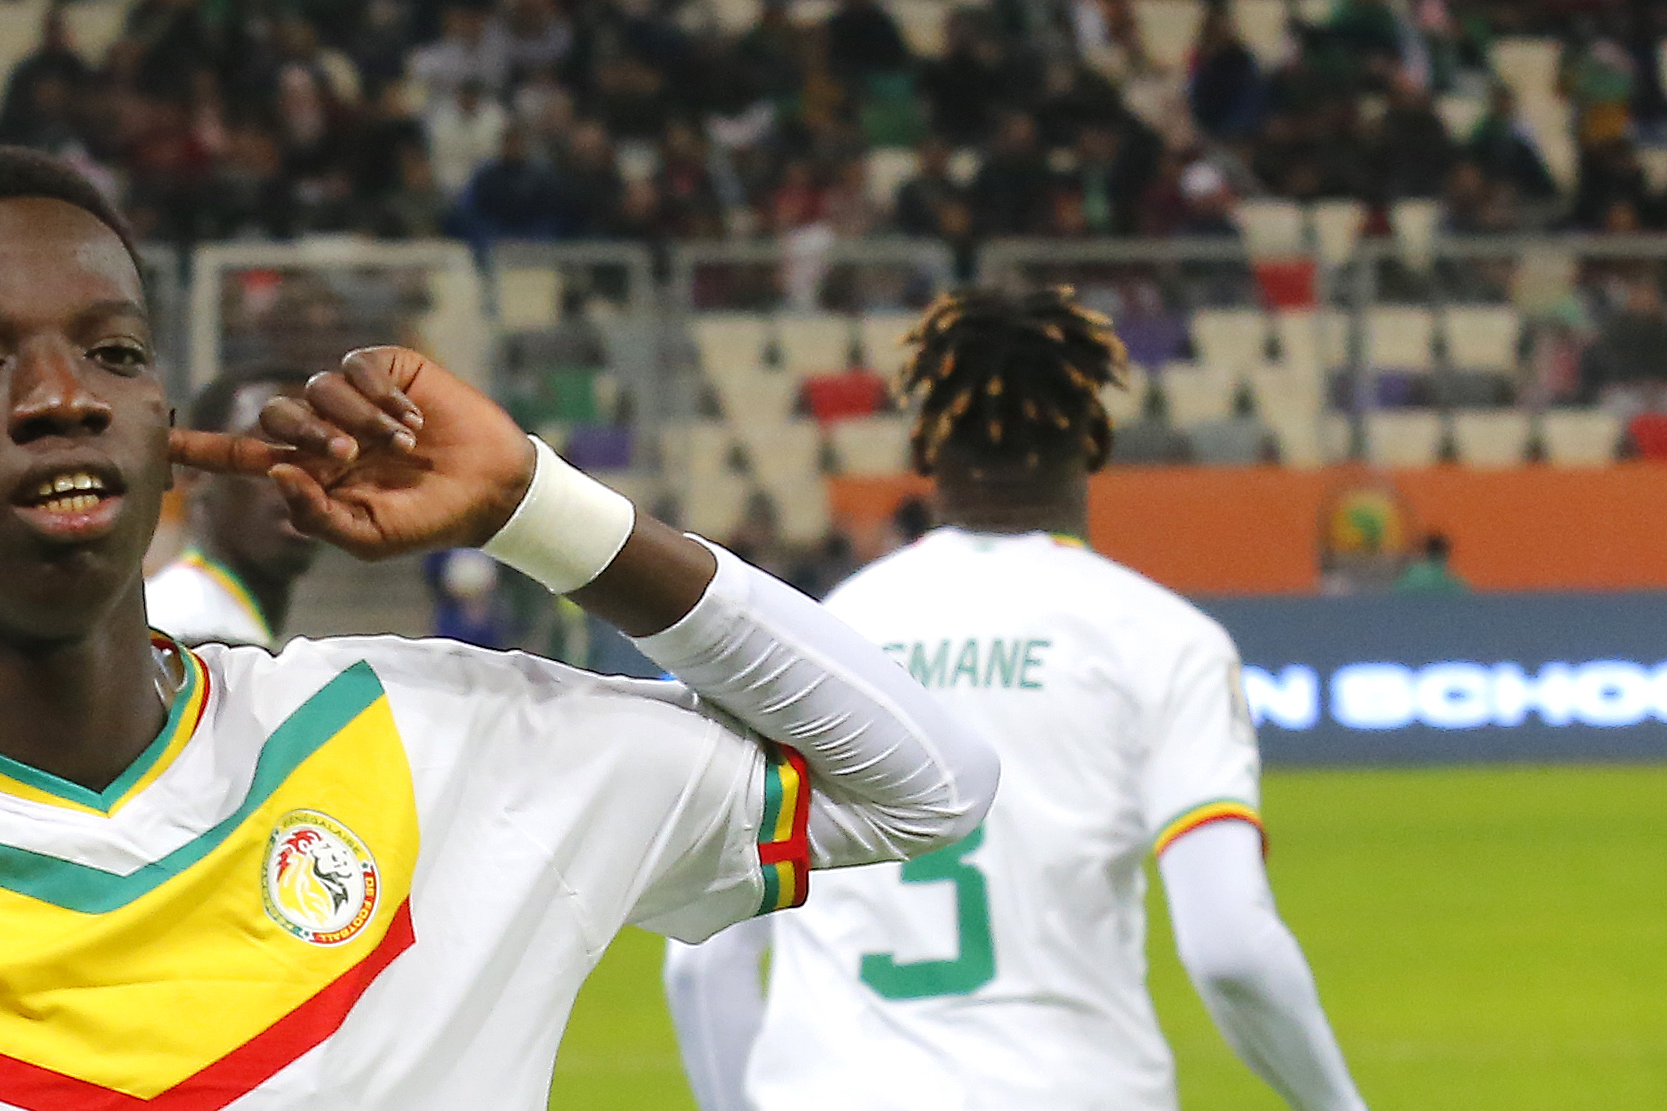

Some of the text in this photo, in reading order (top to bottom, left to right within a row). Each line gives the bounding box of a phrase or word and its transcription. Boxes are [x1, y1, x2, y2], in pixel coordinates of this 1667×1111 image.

[882, 637, 1052, 689] MANE
[1330, 659, 1667, 731] SCHO
[859, 819, 996, 1001] 3
